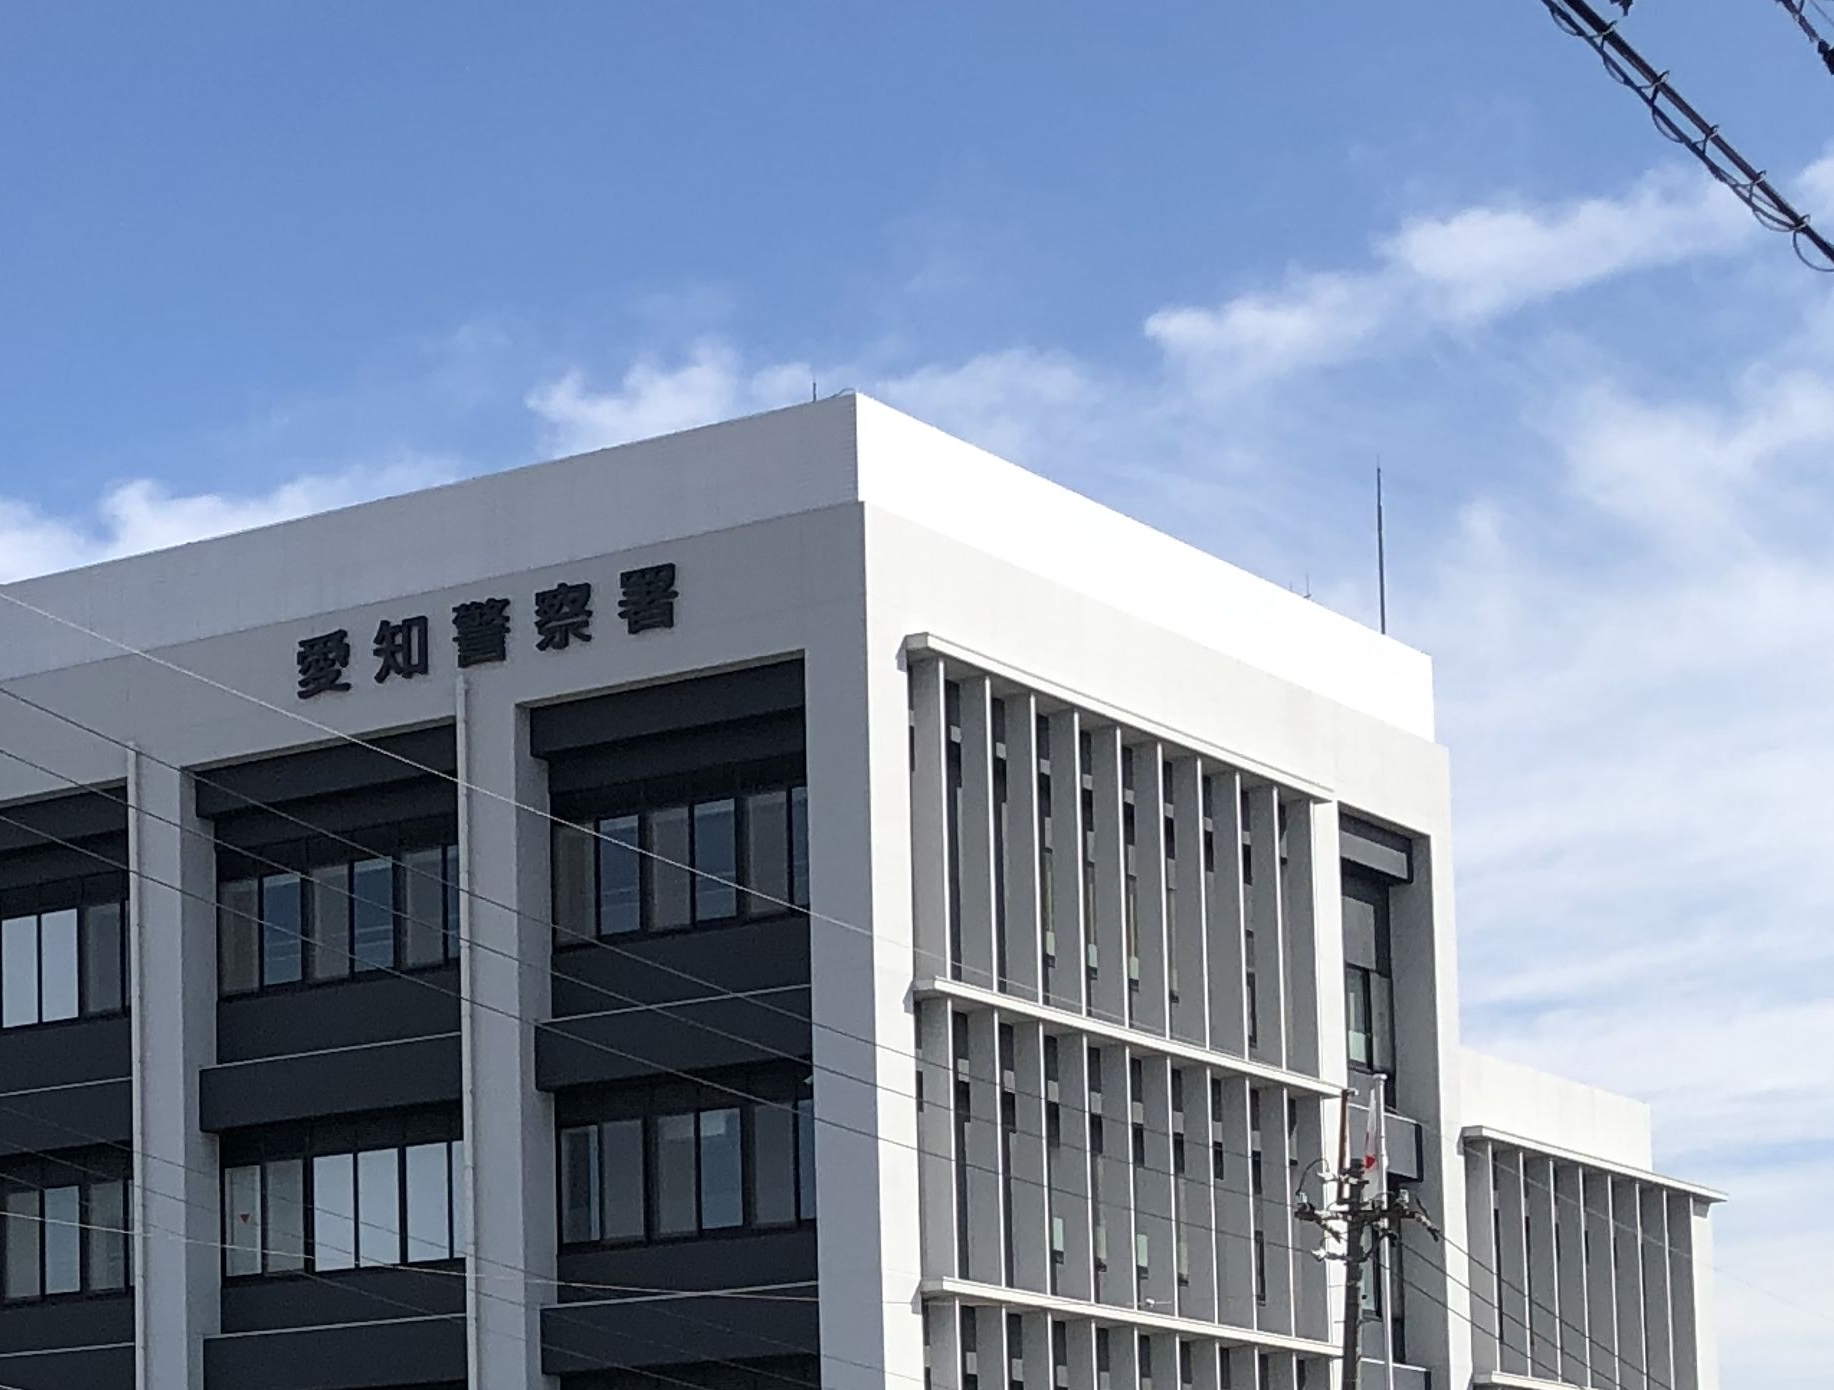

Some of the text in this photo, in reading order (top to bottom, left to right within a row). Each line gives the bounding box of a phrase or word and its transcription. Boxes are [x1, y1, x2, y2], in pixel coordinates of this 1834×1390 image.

[297, 562, 679, 700] 愛知警察署
